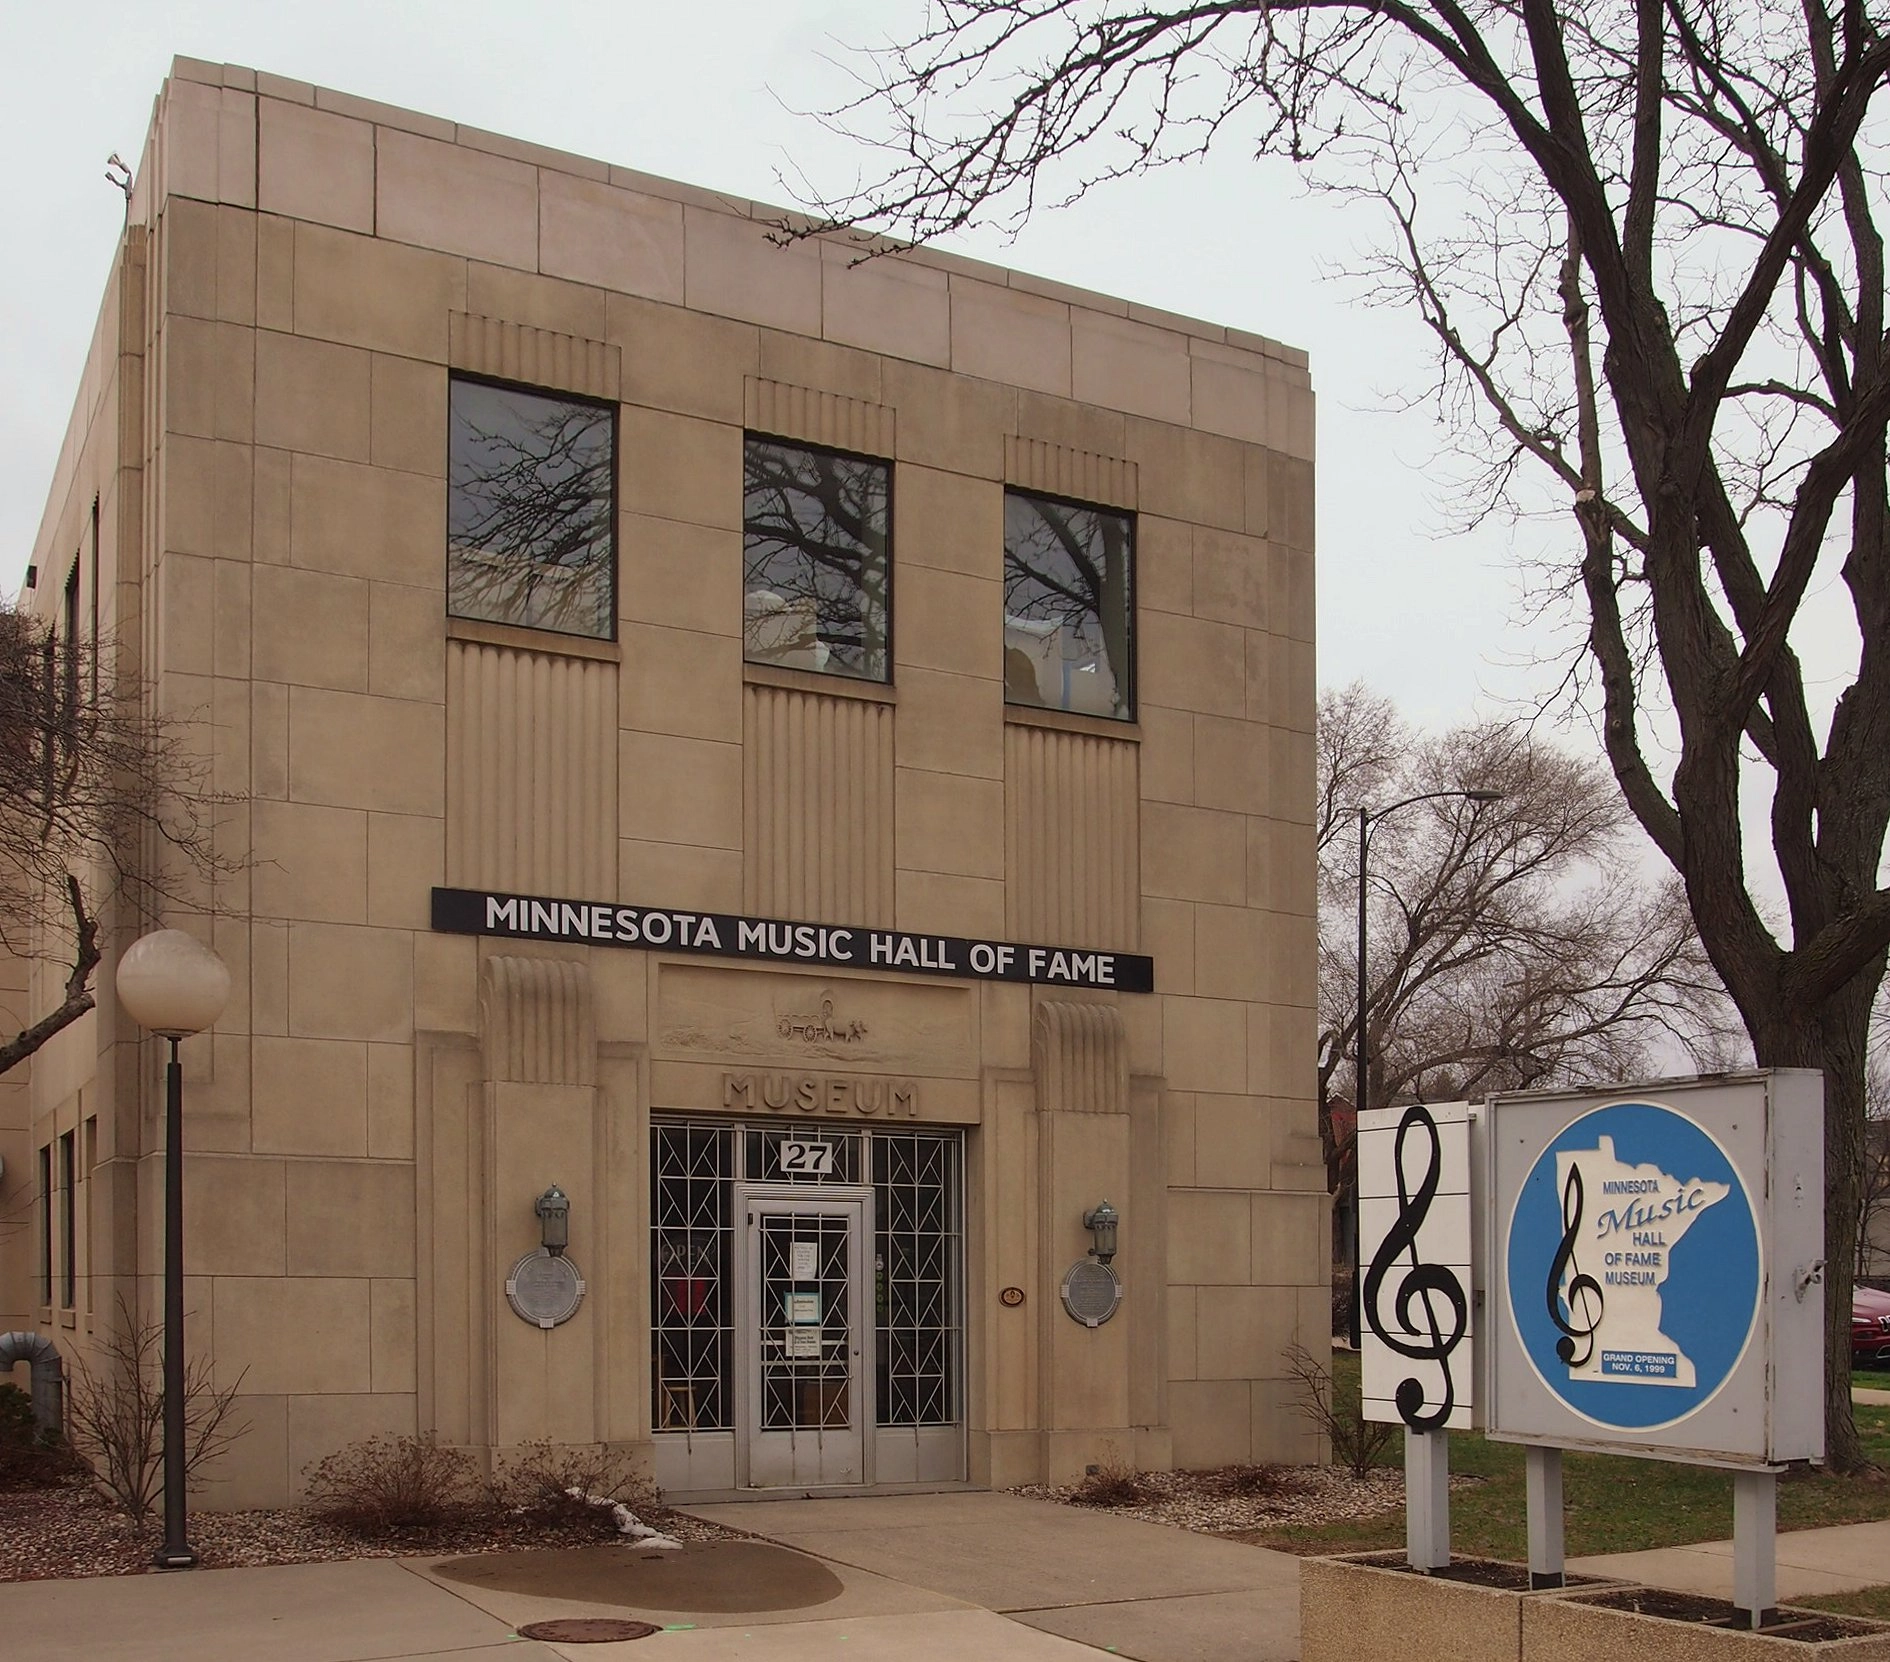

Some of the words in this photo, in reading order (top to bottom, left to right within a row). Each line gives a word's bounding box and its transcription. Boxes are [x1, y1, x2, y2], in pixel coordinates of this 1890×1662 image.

[486, 896, 722, 949] MINNESOTA
[738, 920, 853, 960] MUSIC
[870, 933, 956, 970] HALL
[969, 944, 1015, 974] OF
[1028, 949, 1115, 984] FAME
[722, 1071, 919, 1116] MUSEUM
[785, 1143, 828, 1170] 27
[1603, 1180, 1660, 1194] MINNESOTA
[1597, 1188, 1704, 1239] Music
[1633, 1232, 1666, 1246] HALL
[1605, 1252, 1622, 1266] OF
[1625, 1252, 1661, 1266] FAME
[1605, 1271, 1655, 1285] MUSEUM
[1603, 1353, 1633, 1362] GRAND
[1635, 1355, 1675, 1364] OPENING
[1612, 1363, 1632, 1371] NOV.
[1634, 1364, 1642, 1372] 6,
[1645, 1365, 1665, 1373] 1999
